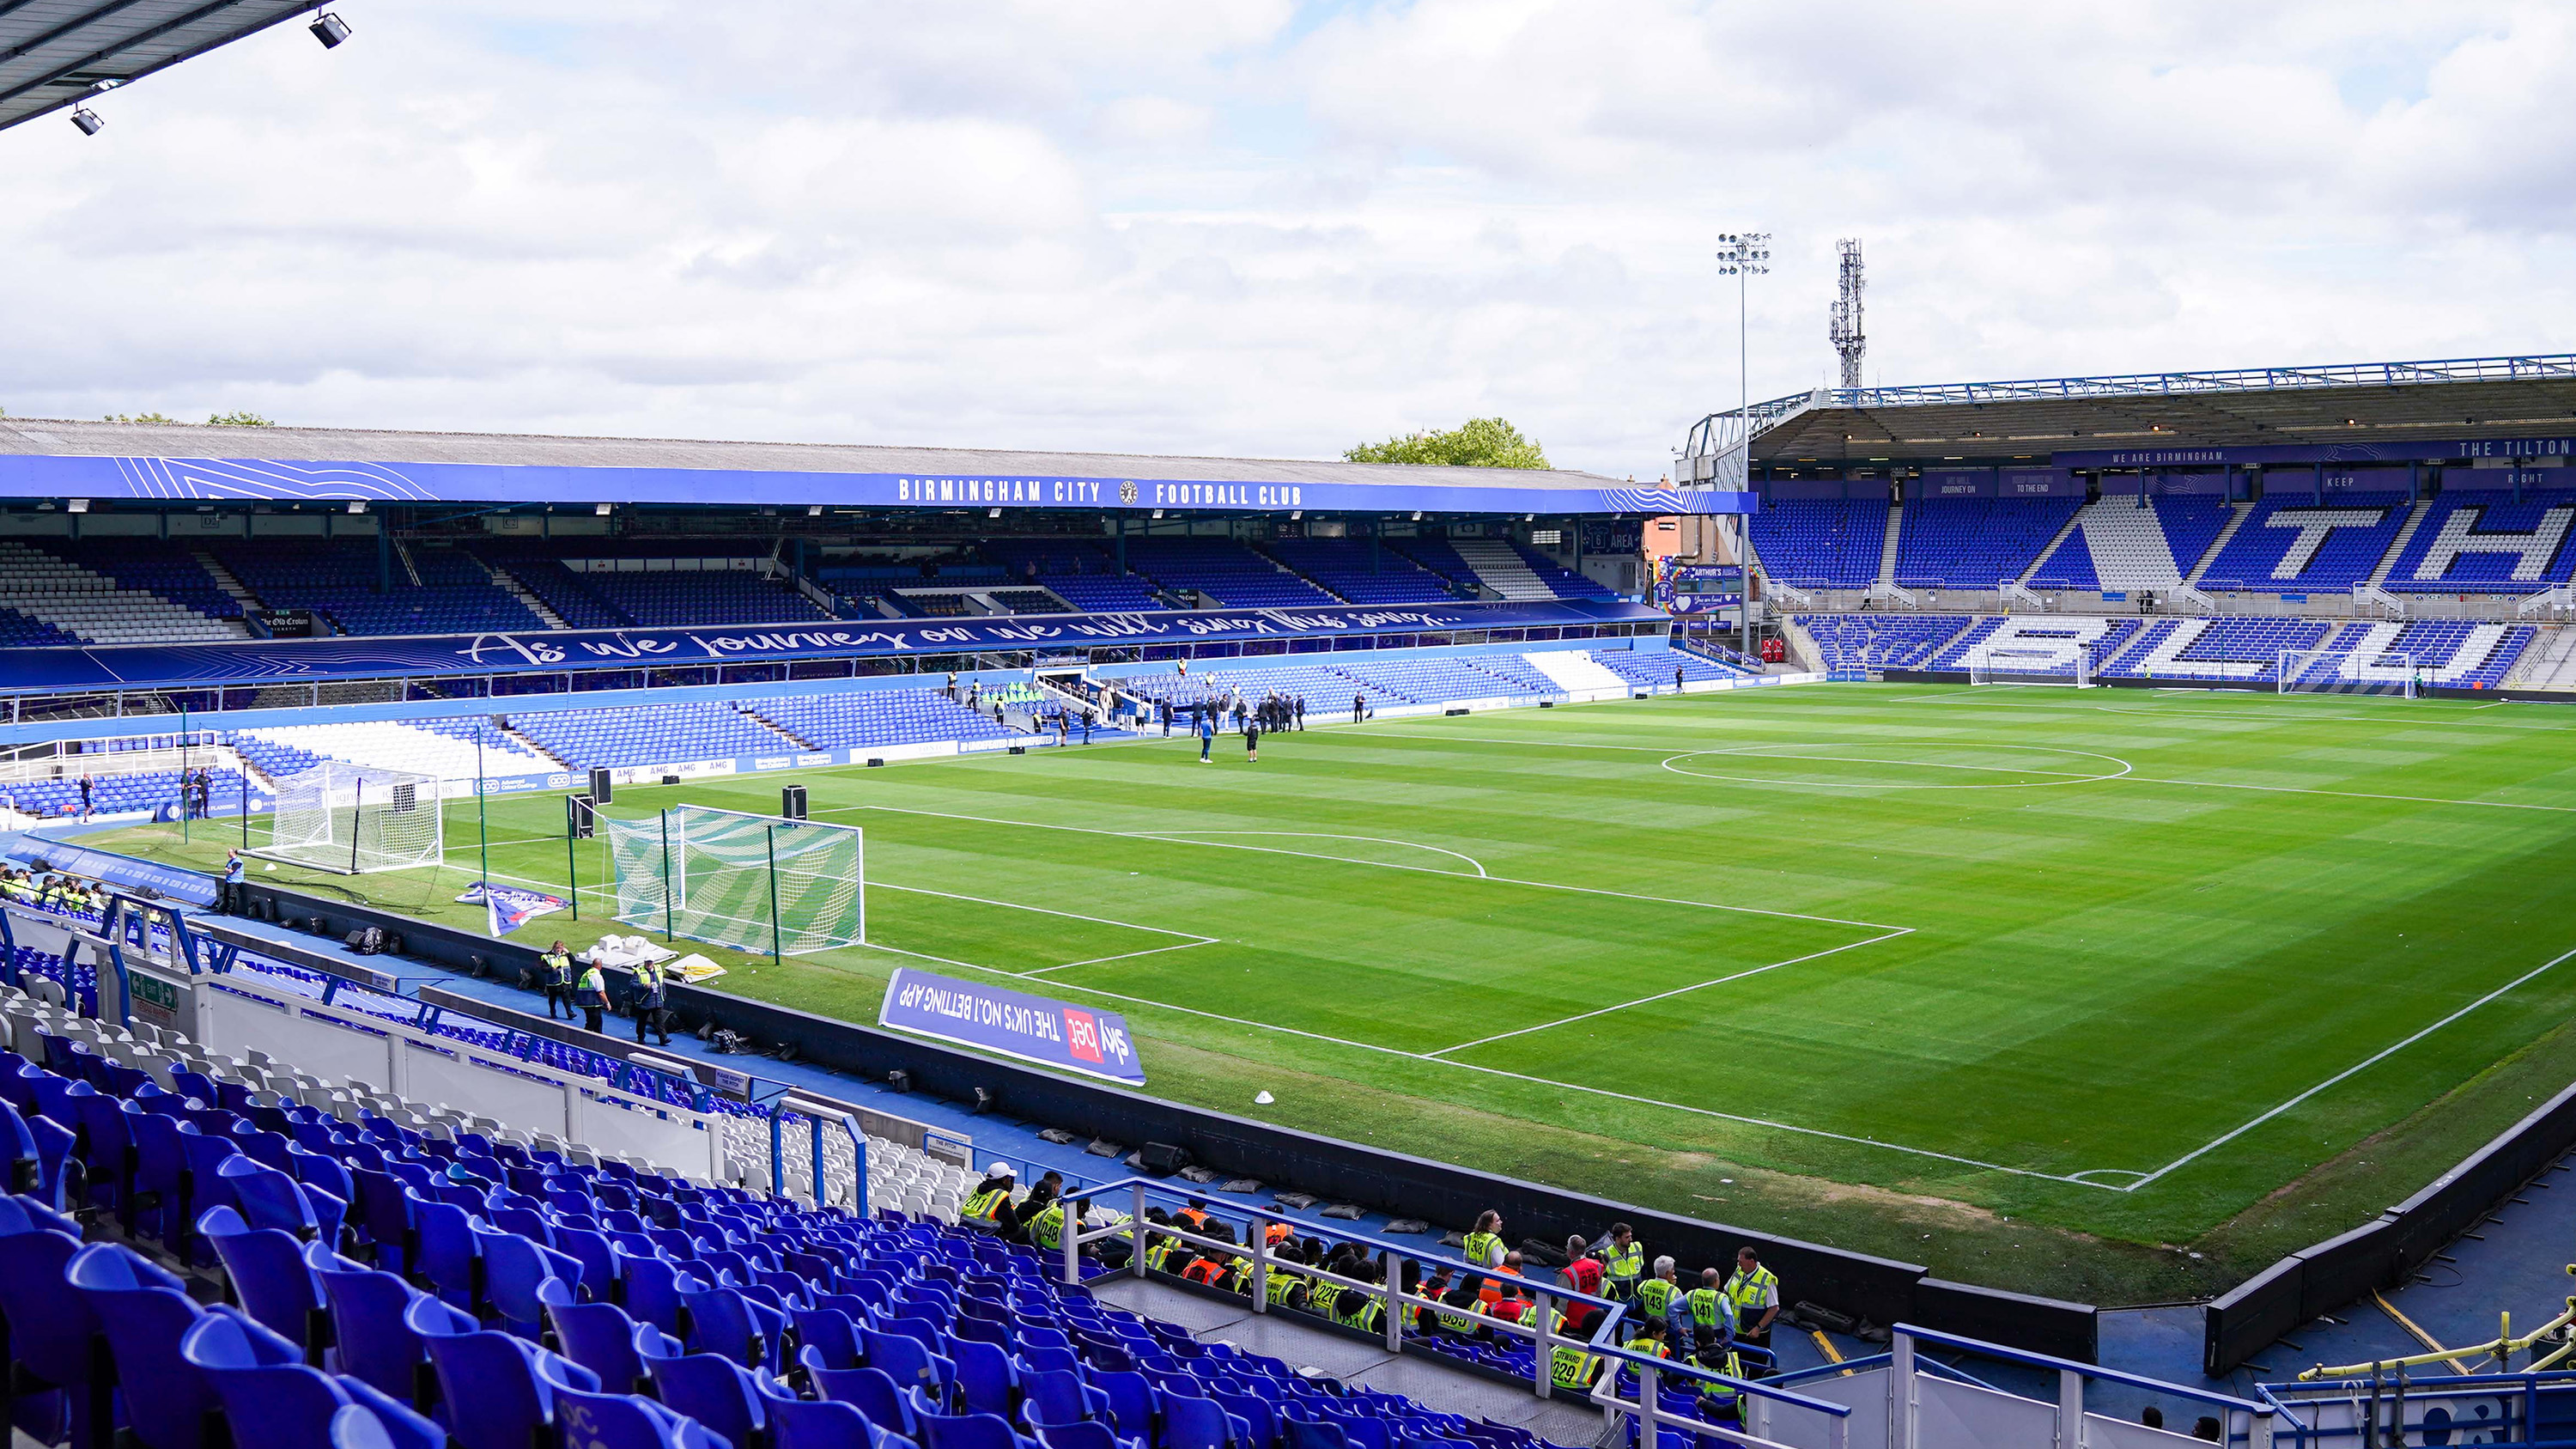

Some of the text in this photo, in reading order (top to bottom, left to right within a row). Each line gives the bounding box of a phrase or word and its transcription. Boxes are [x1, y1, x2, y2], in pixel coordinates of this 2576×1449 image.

[2459, 440, 2570, 456] THE TILTON
[2113, 452, 2227, 463] WE ARE BIRMINGHAM.
[2327, 477, 2354, 487] KEEP
[2508, 473, 2543, 484] RGHT
[899, 478, 1101, 502] BIRMINGHAM CITY
[1941, 484, 1976, 494] JOURNEY ON
[2037, 484, 2049, 492] END
[1156, 484, 1302, 506] FOOTBALL CLUB
[1611, 533, 1633, 548] AREA
[1694, 568, 1722, 576] ARTHUR'S
[1661, 588, 1666, 598] 6
[455, 633, 566, 665] As
[684, 632, 913, 657] journey
[920, 627, 981, 642] on
[1067, 613, 1170, 637] will
[650, 766, 669, 775] AMG
[677, 764, 696, 773] AMG
[709, 761, 727, 770] AMG
[617, 769, 635, 777] AMG
[899, 983, 1060, 1043] THE UK'S NO.1 BETTING APP
[1067, 1017, 1129, 1065] sky bet
[965, 1193, 987, 1212] 211
[1040, 1221, 1060, 1243] 048
[1645, 1286, 1665, 1296] STEWARD
[1644, 1294, 1662, 1311] 143
[1694, 1294, 1713, 1304] STEWARD
[1694, 1302, 1711, 1319] 141
[1555, 1350, 1581, 1364] STEWARD
[1552, 1361, 1577, 1384] 229
